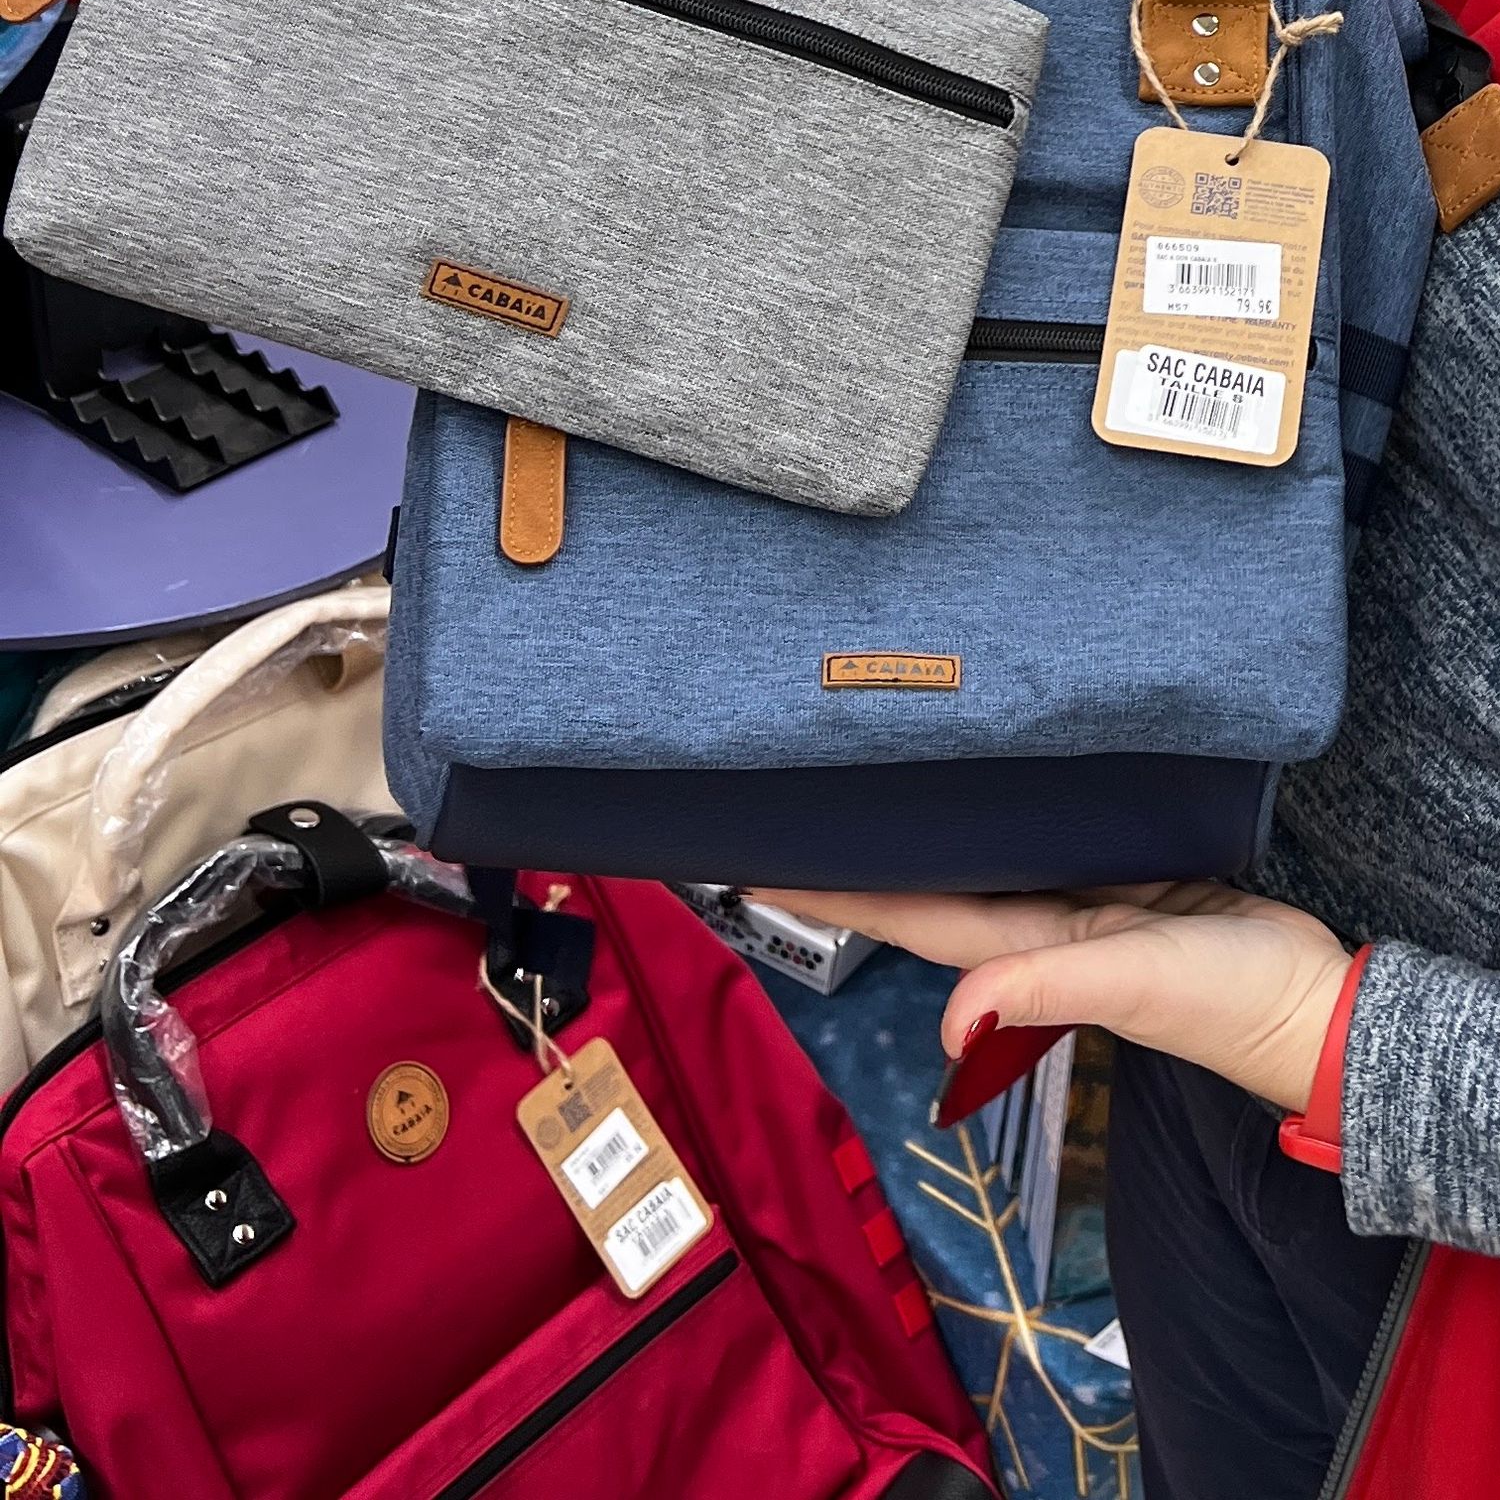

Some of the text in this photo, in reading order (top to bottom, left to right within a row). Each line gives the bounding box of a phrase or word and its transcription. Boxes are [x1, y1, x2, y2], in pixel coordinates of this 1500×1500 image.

[1147, 352, 1265, 397] SAC CABAIA
[1159, 376, 1225, 399] TAILLE
[615, 1218, 638, 1243] SAC
